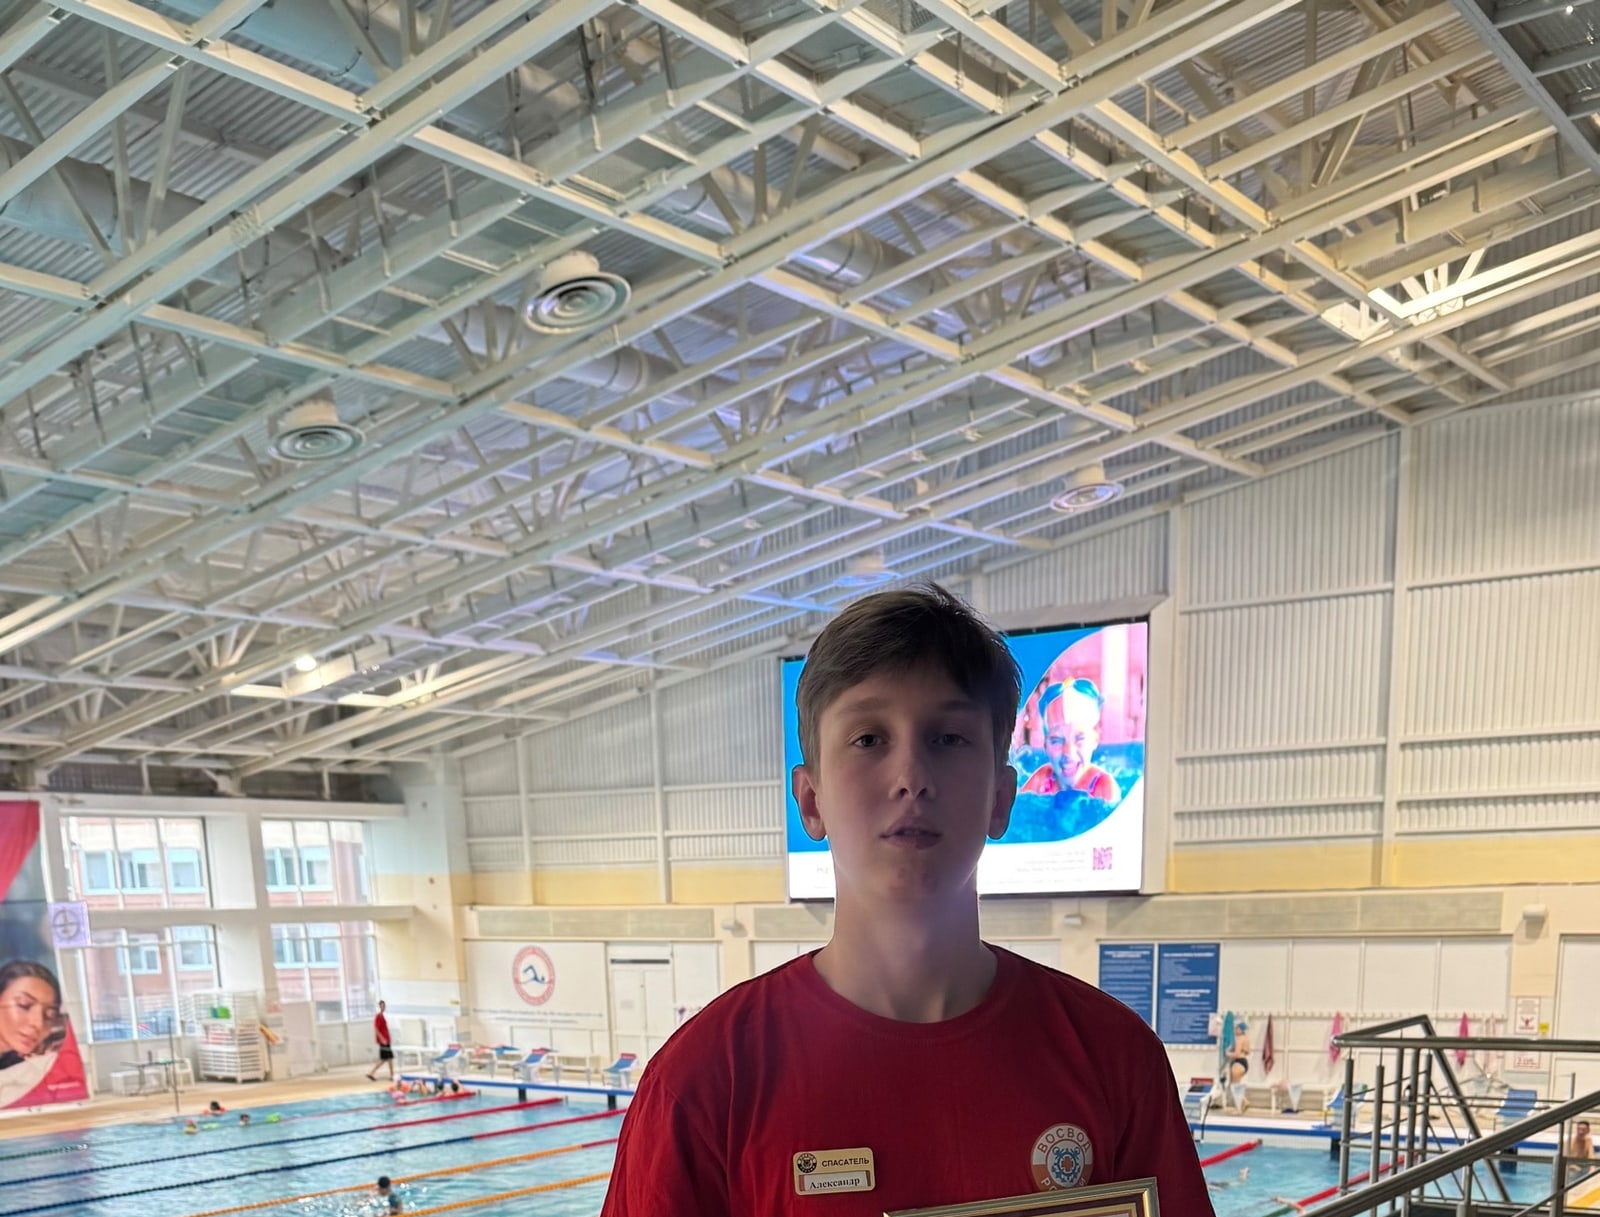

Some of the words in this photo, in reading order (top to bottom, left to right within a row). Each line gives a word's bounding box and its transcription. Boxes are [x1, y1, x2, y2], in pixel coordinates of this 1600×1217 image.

[1037, 1127, 1091, 1153] ВОСВОД
[821, 1158, 870, 1167] СПАСАТЕЛЬ
[809, 1178, 860, 1189] Александр
